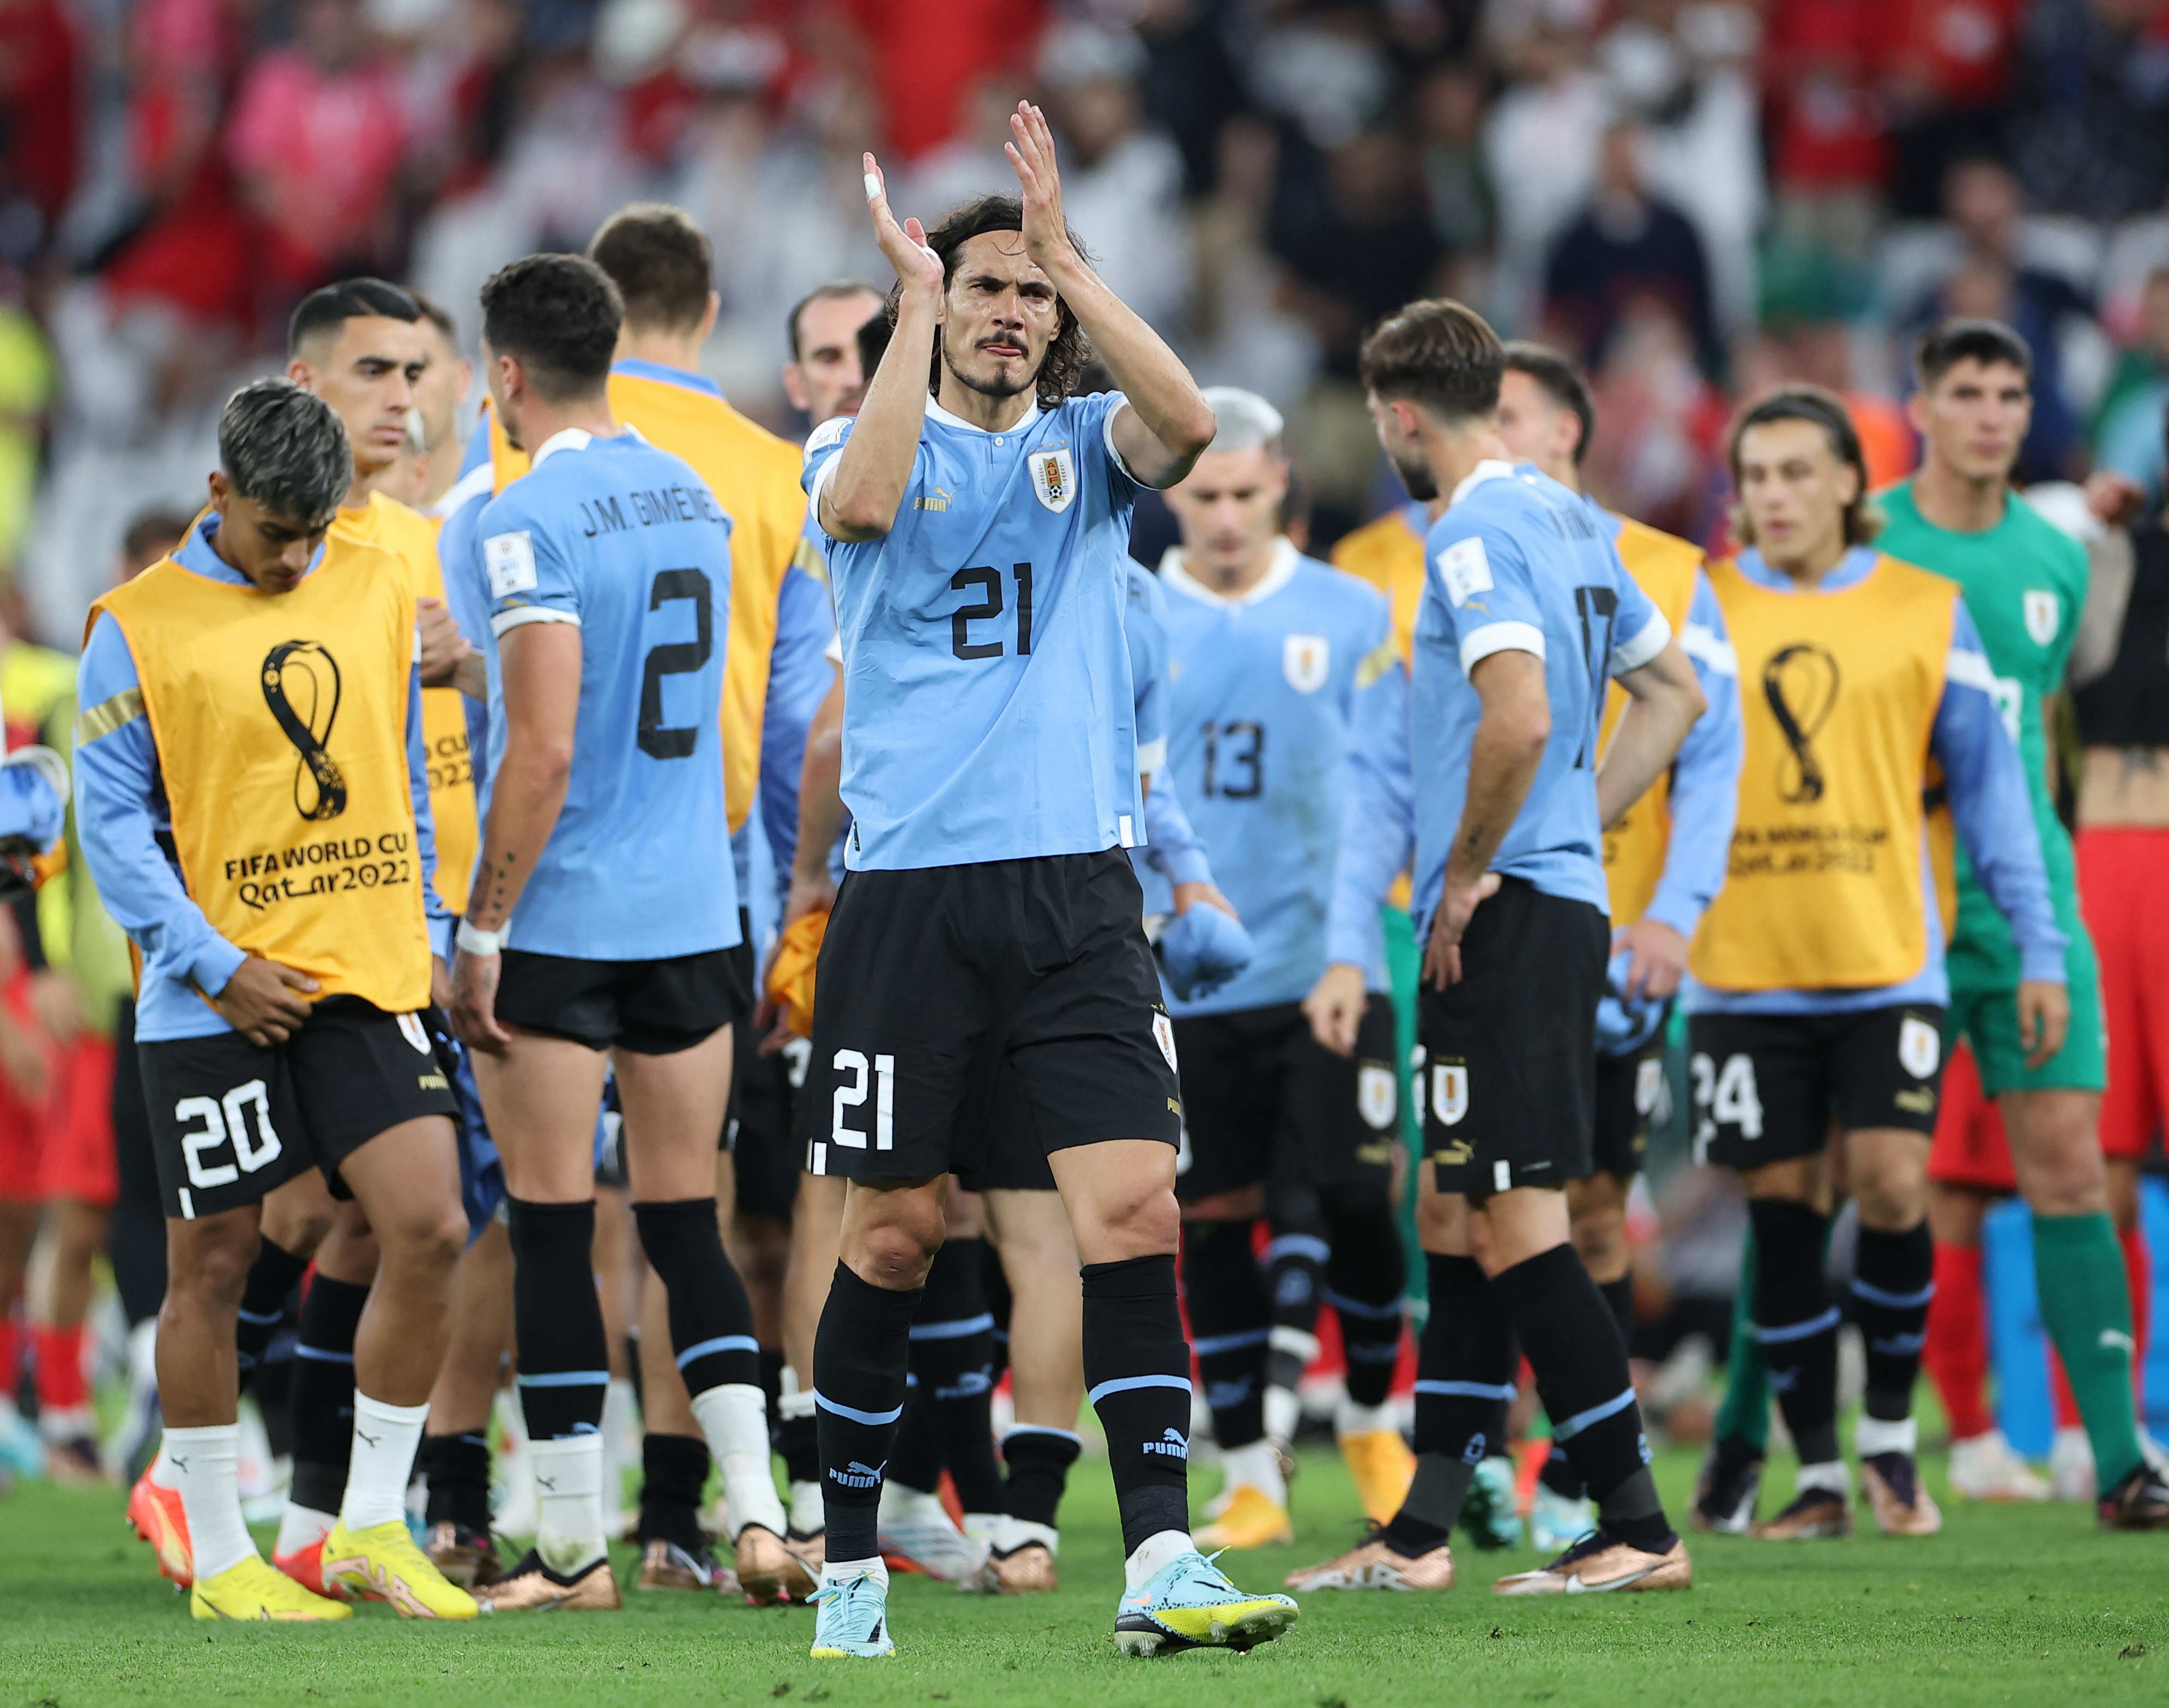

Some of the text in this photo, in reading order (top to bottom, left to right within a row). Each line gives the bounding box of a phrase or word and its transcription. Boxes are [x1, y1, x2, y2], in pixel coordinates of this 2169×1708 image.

[1047, 462, 1059, 484] AUF
[951, 562, 1032, 661] 21
[637, 568, 713, 760] 2
[1202, 720, 1264, 799] 13
[225, 854, 279, 880] FIFA
[283, 837, 371, 868] WORLD
[175, 1078, 283, 1190] 20
[832, 1048, 895, 1150] 21
[829, 1466, 875, 1488] PUMA
[1143, 1441, 1186, 1460] PUMA
